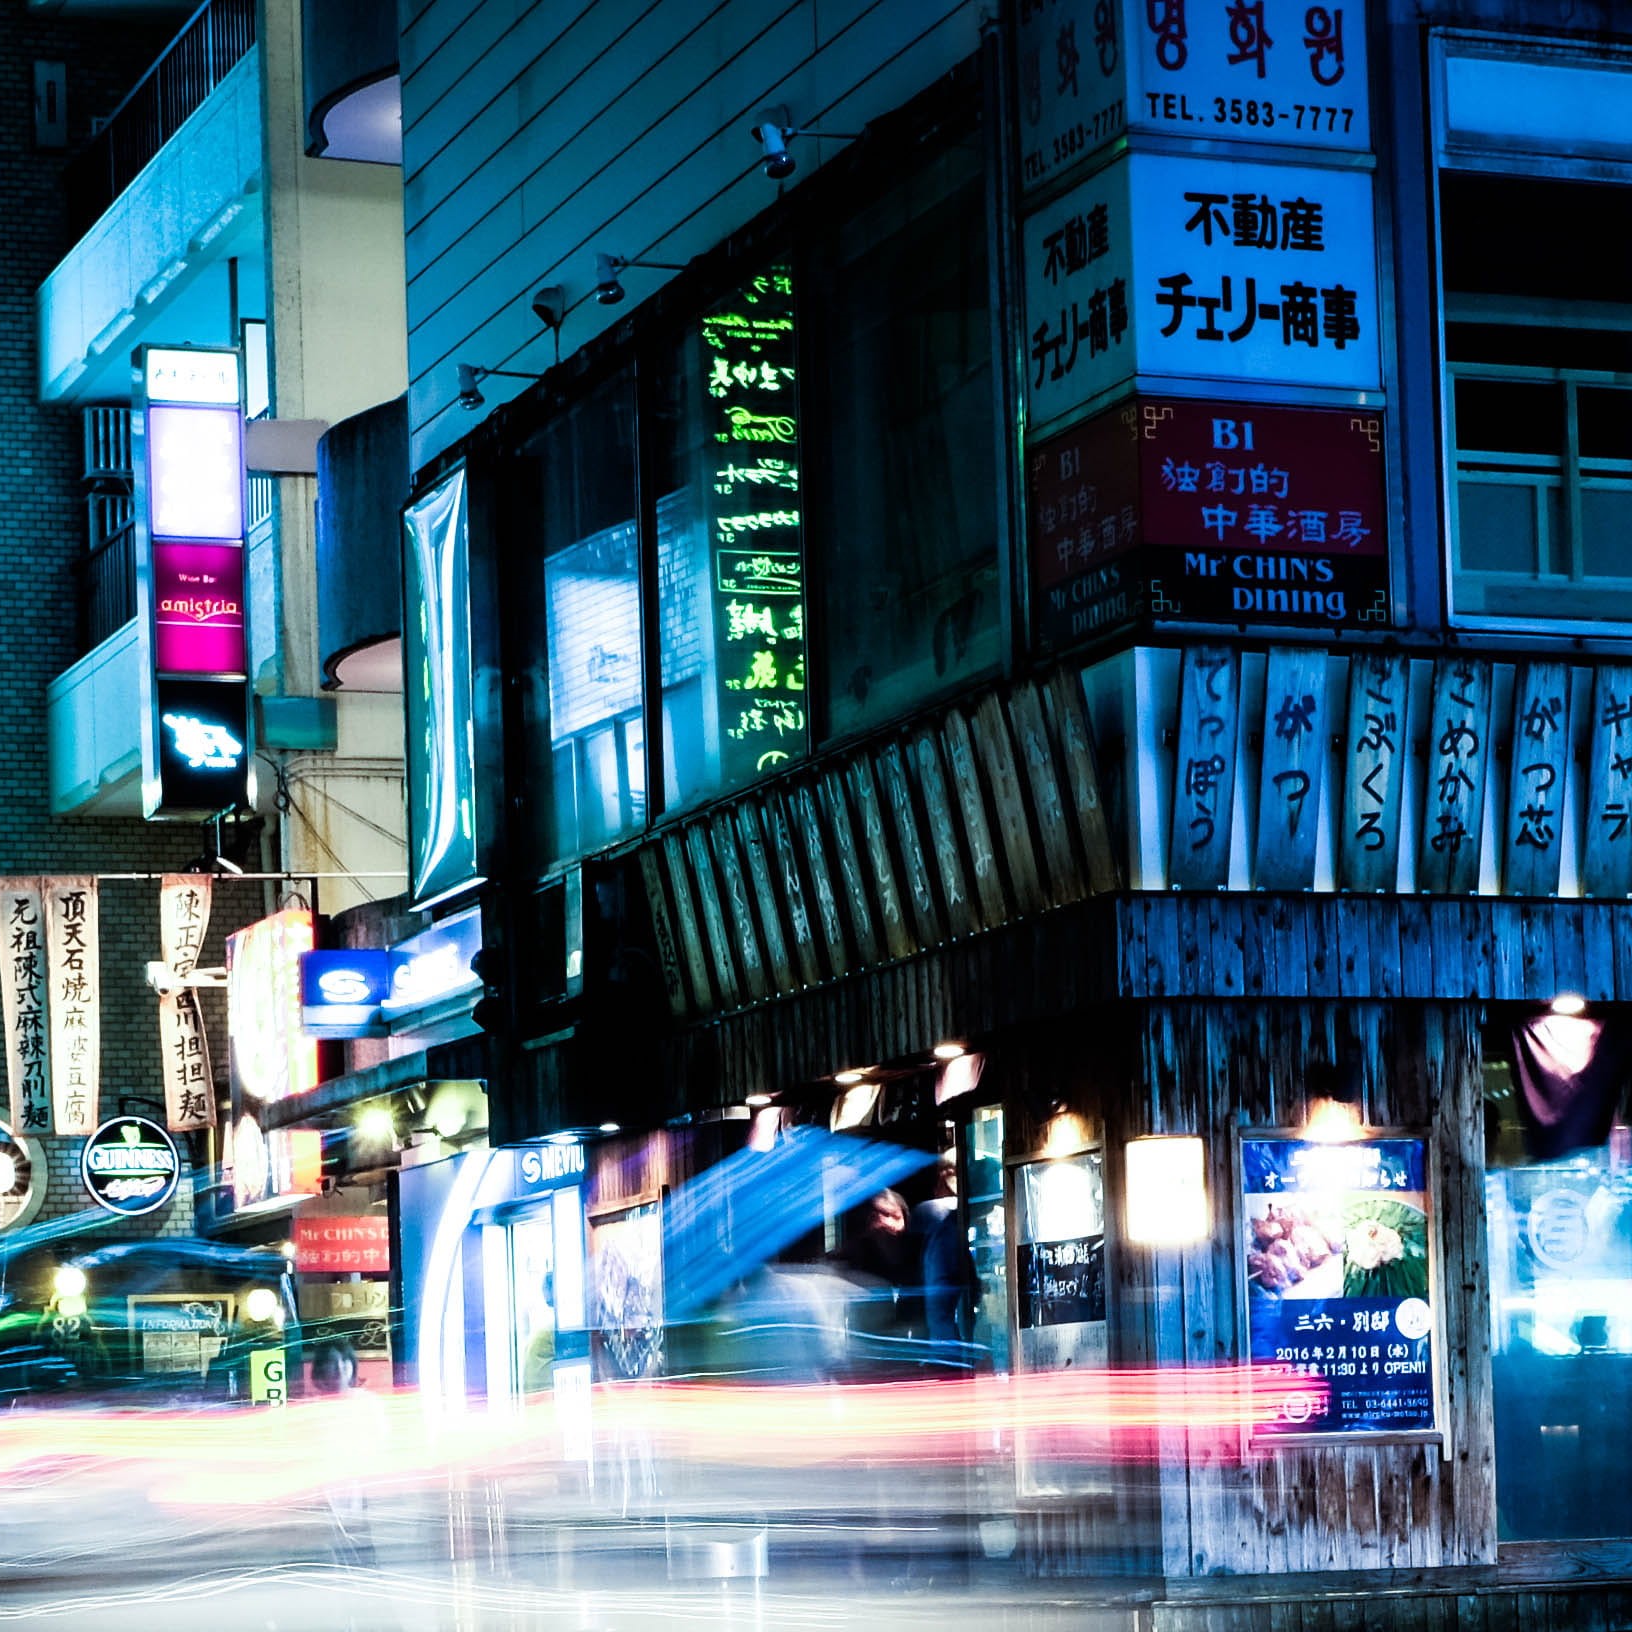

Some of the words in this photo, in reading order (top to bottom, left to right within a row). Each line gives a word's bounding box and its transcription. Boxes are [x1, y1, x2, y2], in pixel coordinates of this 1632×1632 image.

[1145, 92, 1204, 123] TEL.
[1213, 96, 1354, 134] 3583-7777
[1041, 203, 1110, 288] 不動産
[1183, 191, 1325, 253] 不動産
[1031, 275, 1129, 391] チェリー商事
[1155, 272, 1361, 351] チェリー商事
[1212, 417, 1255, 452] B1
[1200, 504, 1371, 547] 中華酒房
[1515, 696, 1562, 851] がつ芯
[87, 1148, 174, 1171] GUINNESS
